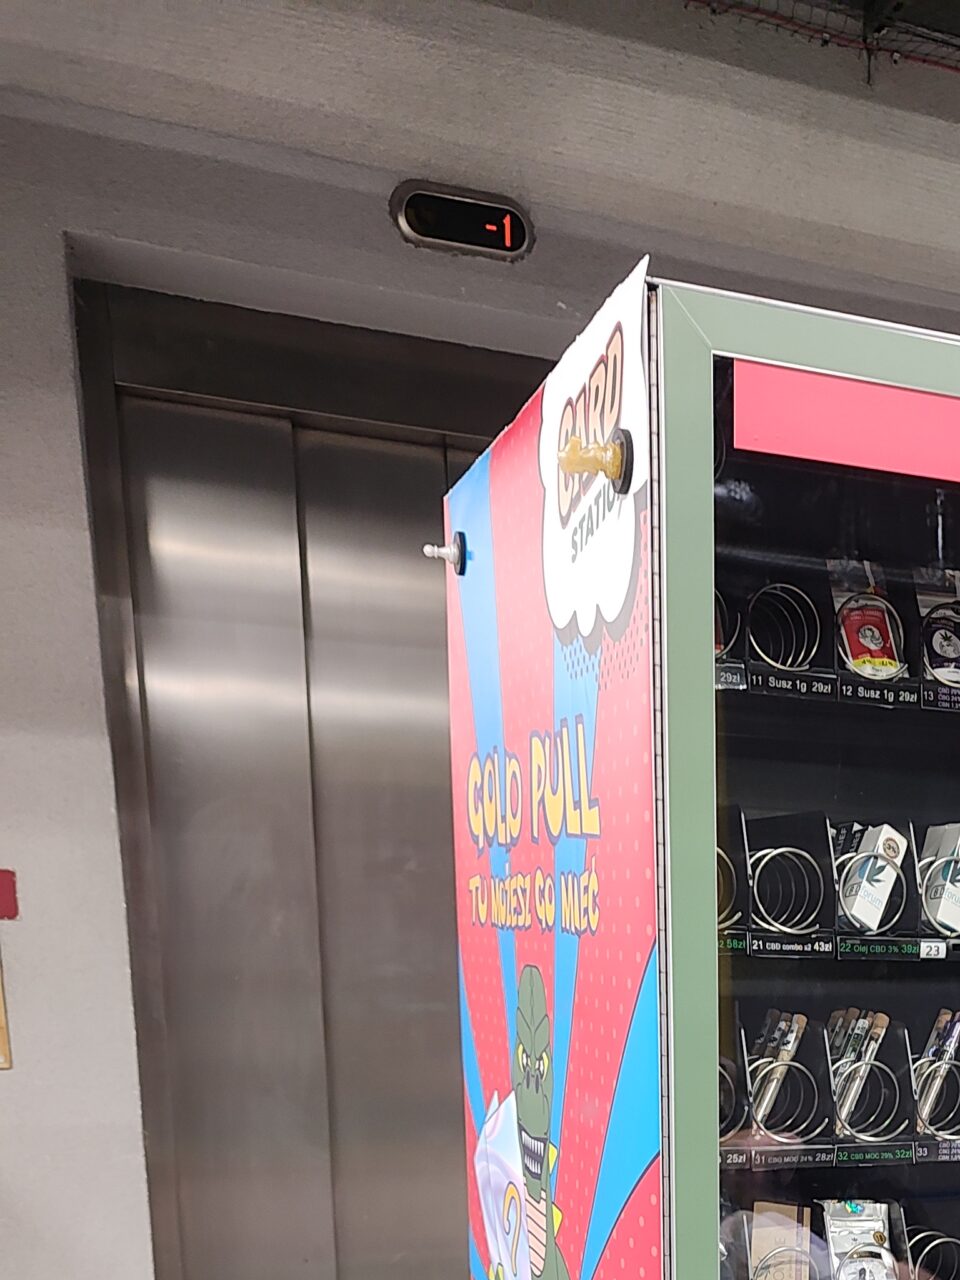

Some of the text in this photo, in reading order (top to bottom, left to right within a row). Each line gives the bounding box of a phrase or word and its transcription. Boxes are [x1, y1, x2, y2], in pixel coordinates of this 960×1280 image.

[485, 213, 512, 248] -1
[571, 482, 622, 564] STATIO
[752, 675, 762, 685] 11
[768, 676, 793, 690] Susz
[796, 680, 807, 693] 1g
[842, 685, 853, 696] 12
[857, 686, 881, 699] Susz
[883, 689, 894, 702] 1g
[924, 691, 934, 701] 13
[467, 713, 601, 858] GOLD PULL
[468, 873, 488, 925] TU
[534, 867, 556, 934] GO
[560, 854, 600, 936] MIEĆ
[752, 939, 763, 950] 21
[813, 941, 832, 952] 43zł
[840, 943, 851, 953] 22
[870, 945, 885, 953] CBD
[925, 945, 940, 957] 23
[837, 1151, 848, 1161] 32
[895, 1149, 912, 1158] 32zł
[917, 1147, 928, 1157] 33
